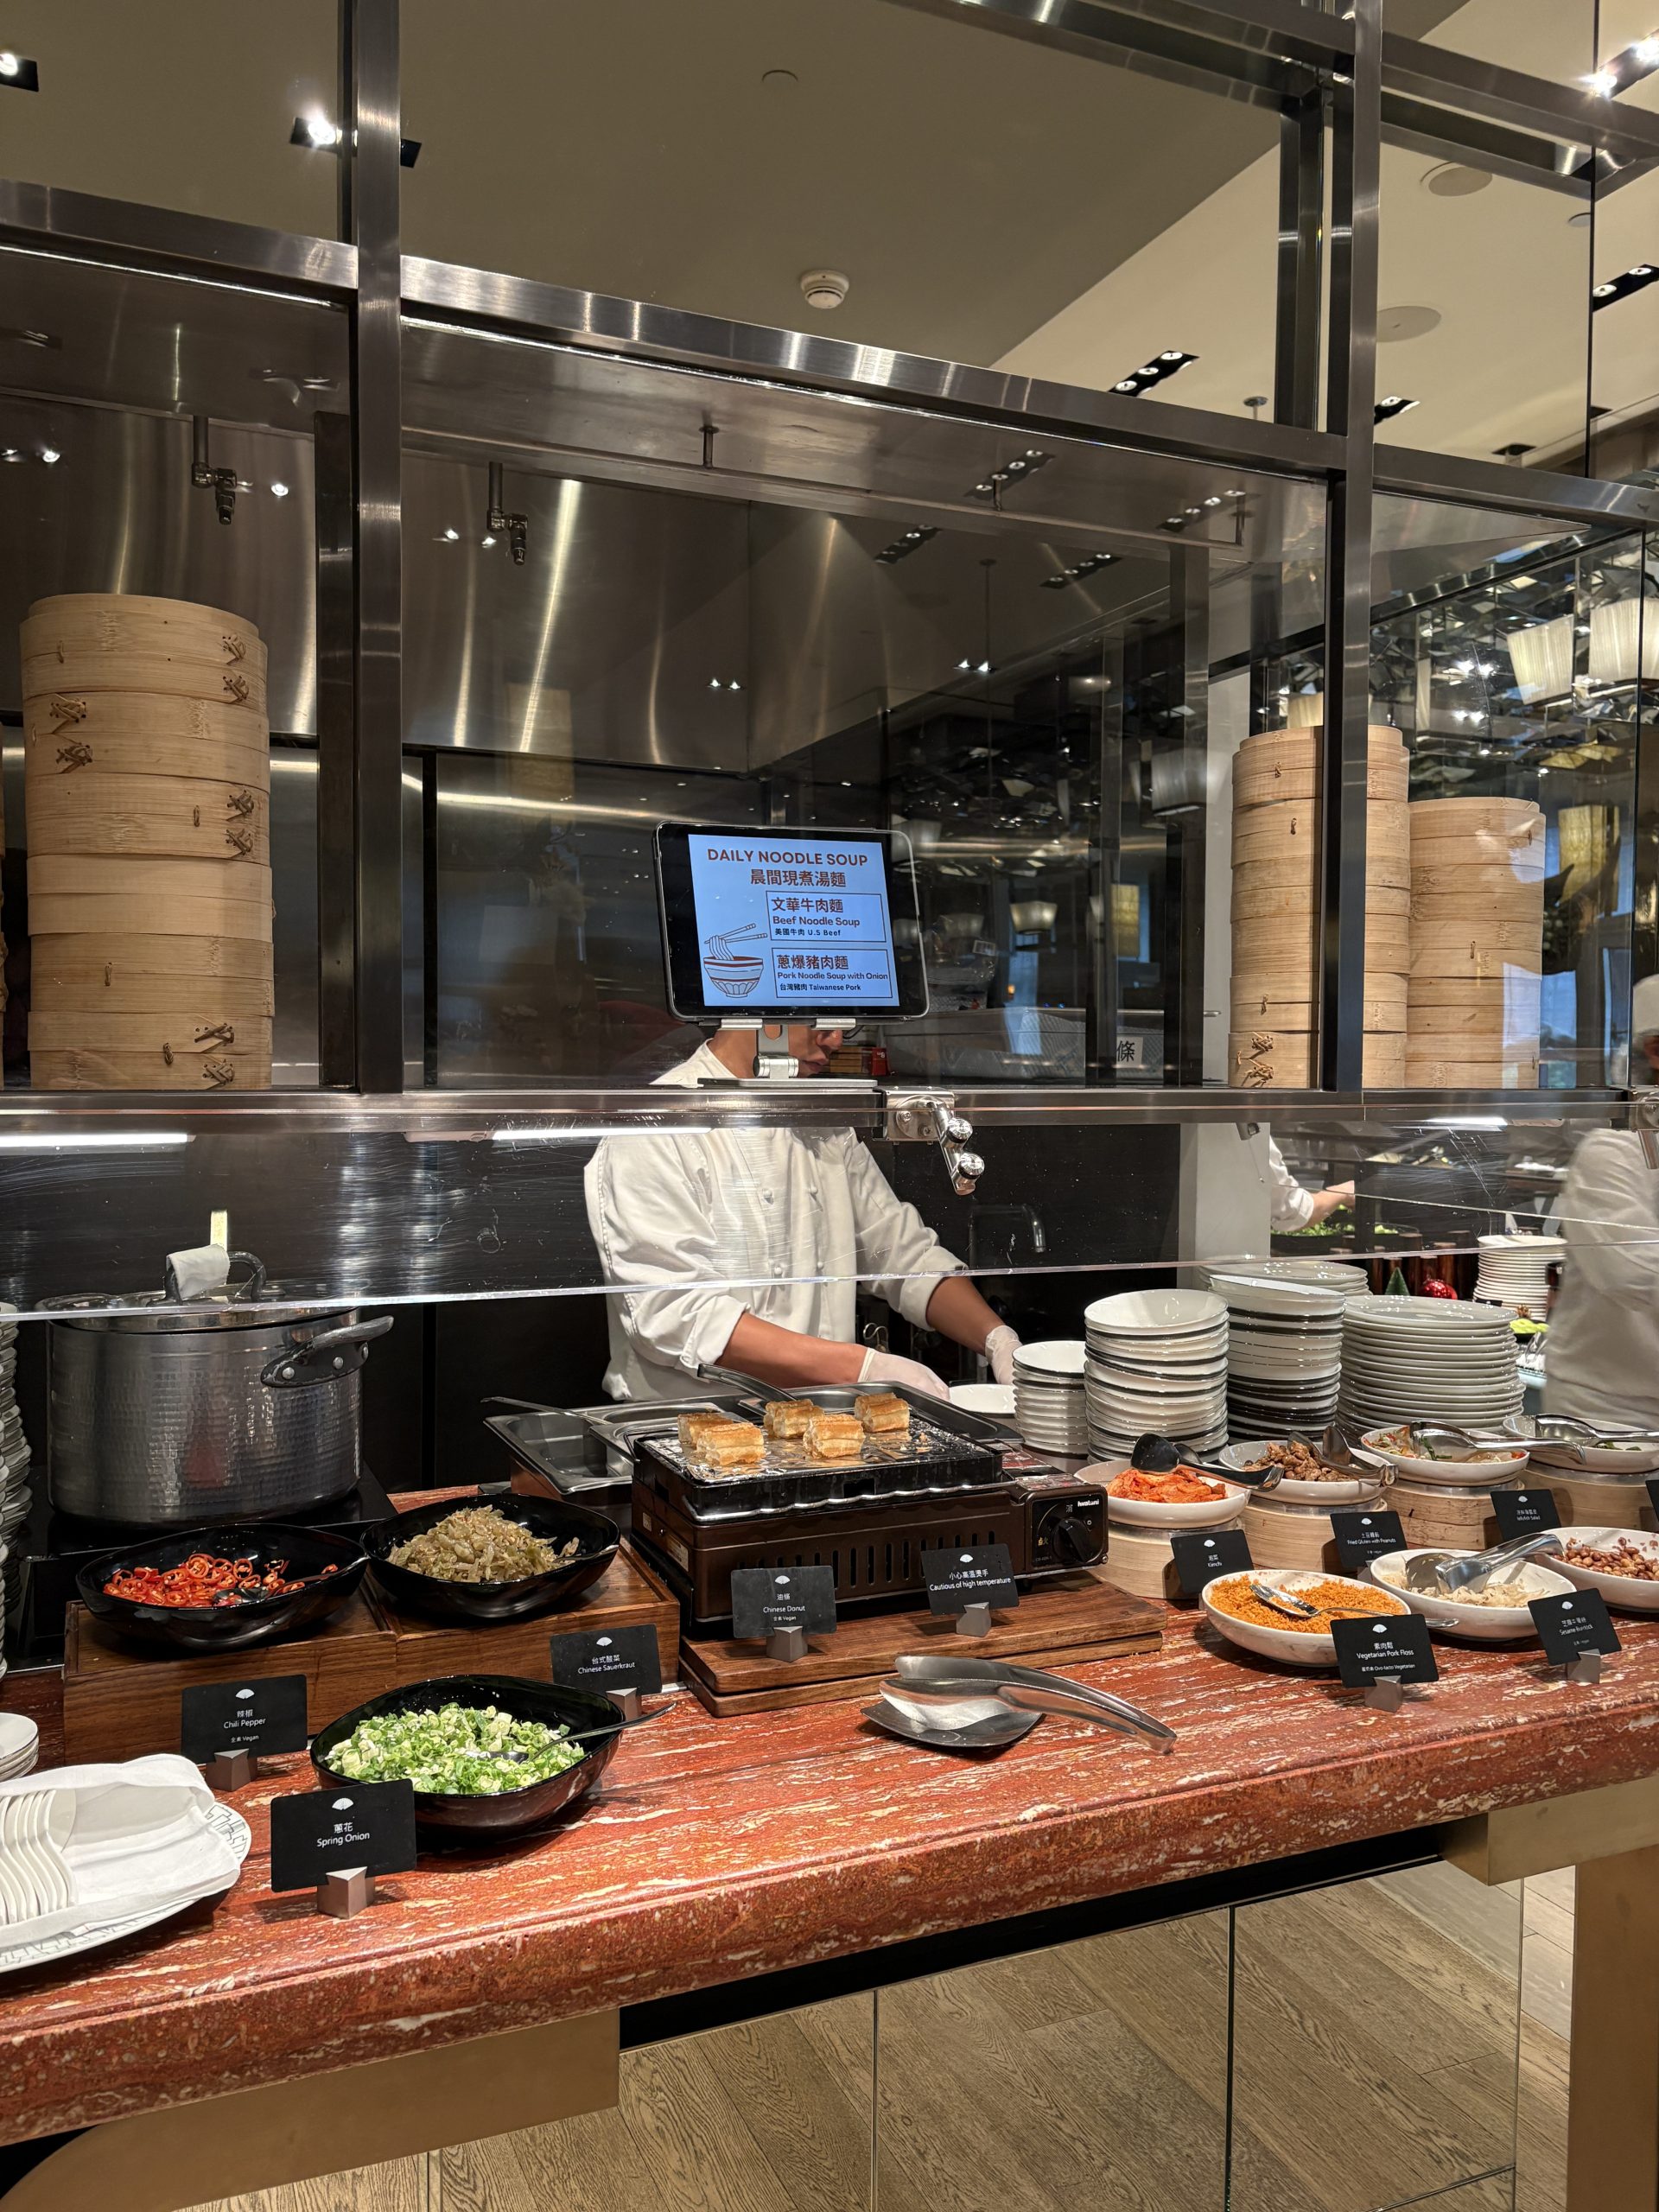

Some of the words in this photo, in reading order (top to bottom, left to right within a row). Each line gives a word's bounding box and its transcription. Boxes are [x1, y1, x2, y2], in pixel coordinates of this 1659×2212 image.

[707, 849, 753, 862] DAILY
[759, 851, 823, 864] NOODLE
[827, 854, 868, 866] SOUP
[750, 868, 846, 887] 晨間現煮湯麵
[772, 897, 843, 913] 文華牛肉麵
[772, 916, 797, 925] Beef
[799, 917, 833, 925] Noodle
[836, 918, 860, 928] Soup
[1077, 1498, 1100, 1507] Iwatani
[929, 1582, 956, 1591] Cautious
[956, 1580, 963, 1589] of
[962, 1580, 976, 1589] high
[976, 1577, 1012, 1586] temperature
[1357, 1650, 1387, 1661] Vegetarian
[577, 1666, 602, 1675] Chinese
[602, 1662, 636, 1671] Sauerkraut
[224, 1719, 239, 1729] Chili
[240, 1718, 266, 1727] Pepper
[316, 1836, 344, 1848] Spring
[345, 1832, 371, 1842] Onion
